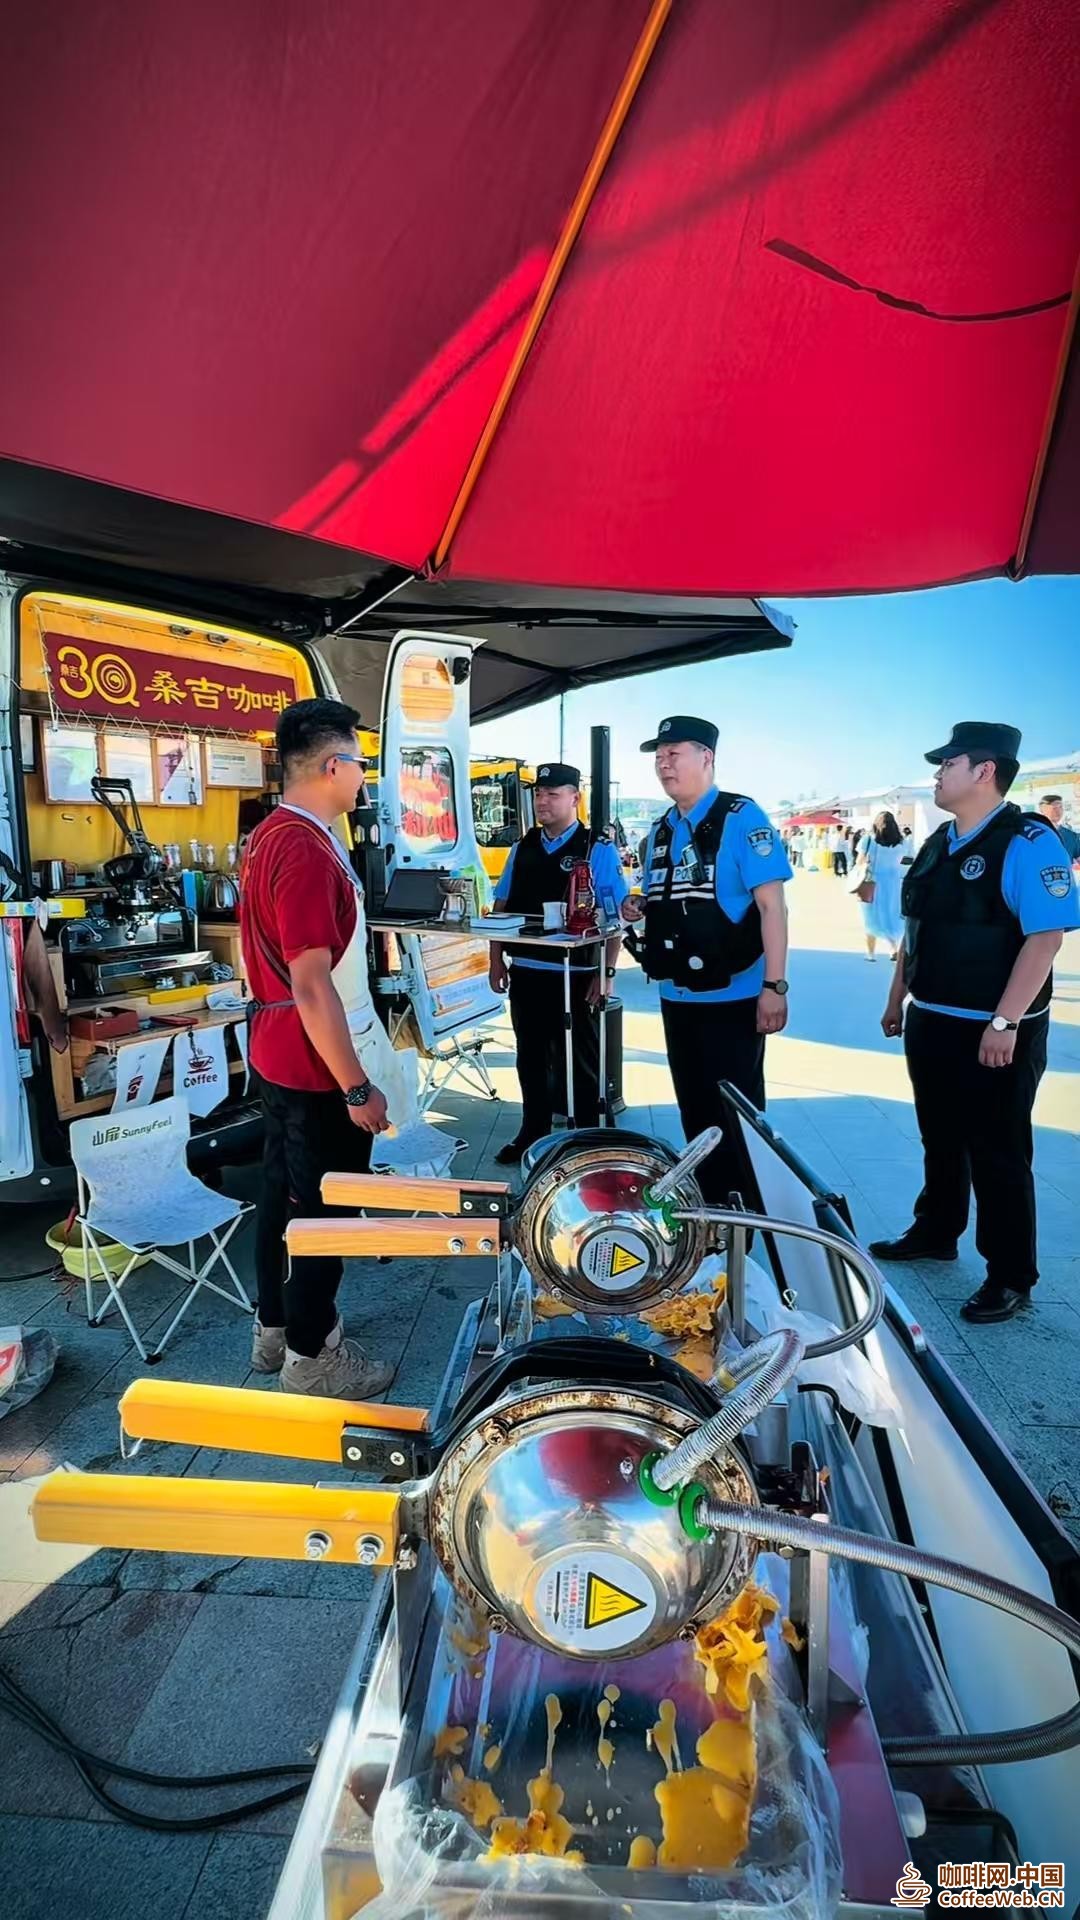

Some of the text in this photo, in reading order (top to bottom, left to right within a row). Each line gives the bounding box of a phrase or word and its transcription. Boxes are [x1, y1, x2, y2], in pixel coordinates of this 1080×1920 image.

[144, 670, 292, 713] 桑吉咖啡
[183, 1074, 218, 1088] Coffee
[121, 1115, 172, 1138] SunnyFeel
